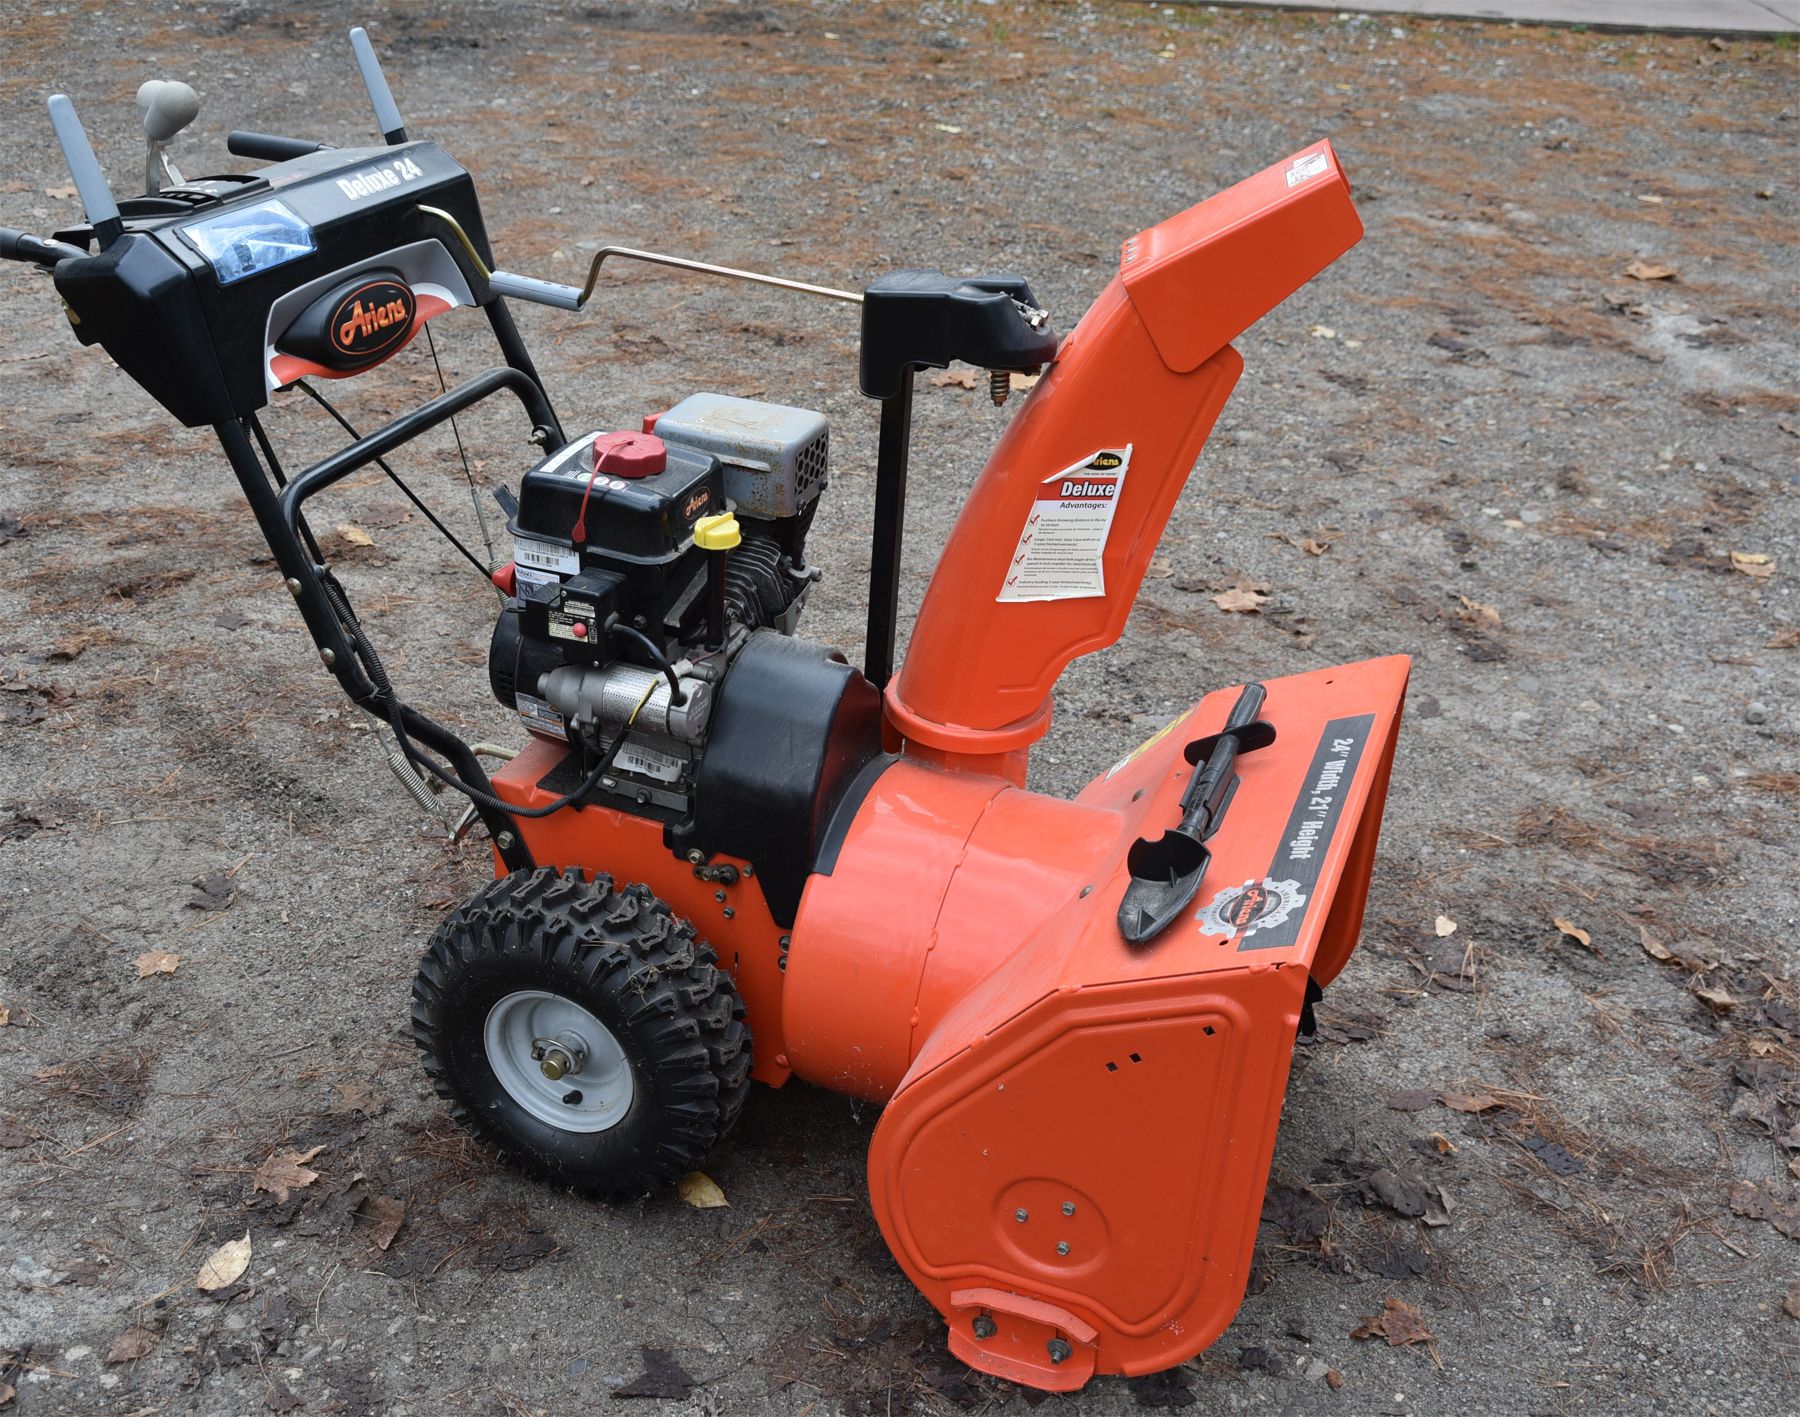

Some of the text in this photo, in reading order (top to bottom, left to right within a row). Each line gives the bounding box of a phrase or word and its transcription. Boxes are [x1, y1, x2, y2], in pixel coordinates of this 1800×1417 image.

[335, 157, 424, 201] Deluxe 24
[339, 298, 406, 346] Ariens
[1093, 456, 1120, 466] riens
[1060, 481, 1115, 497] Deluxe
[1289, 738, 1354, 860] 24" Width, 21" Height
[1236, 889, 1264, 925] Ariens
